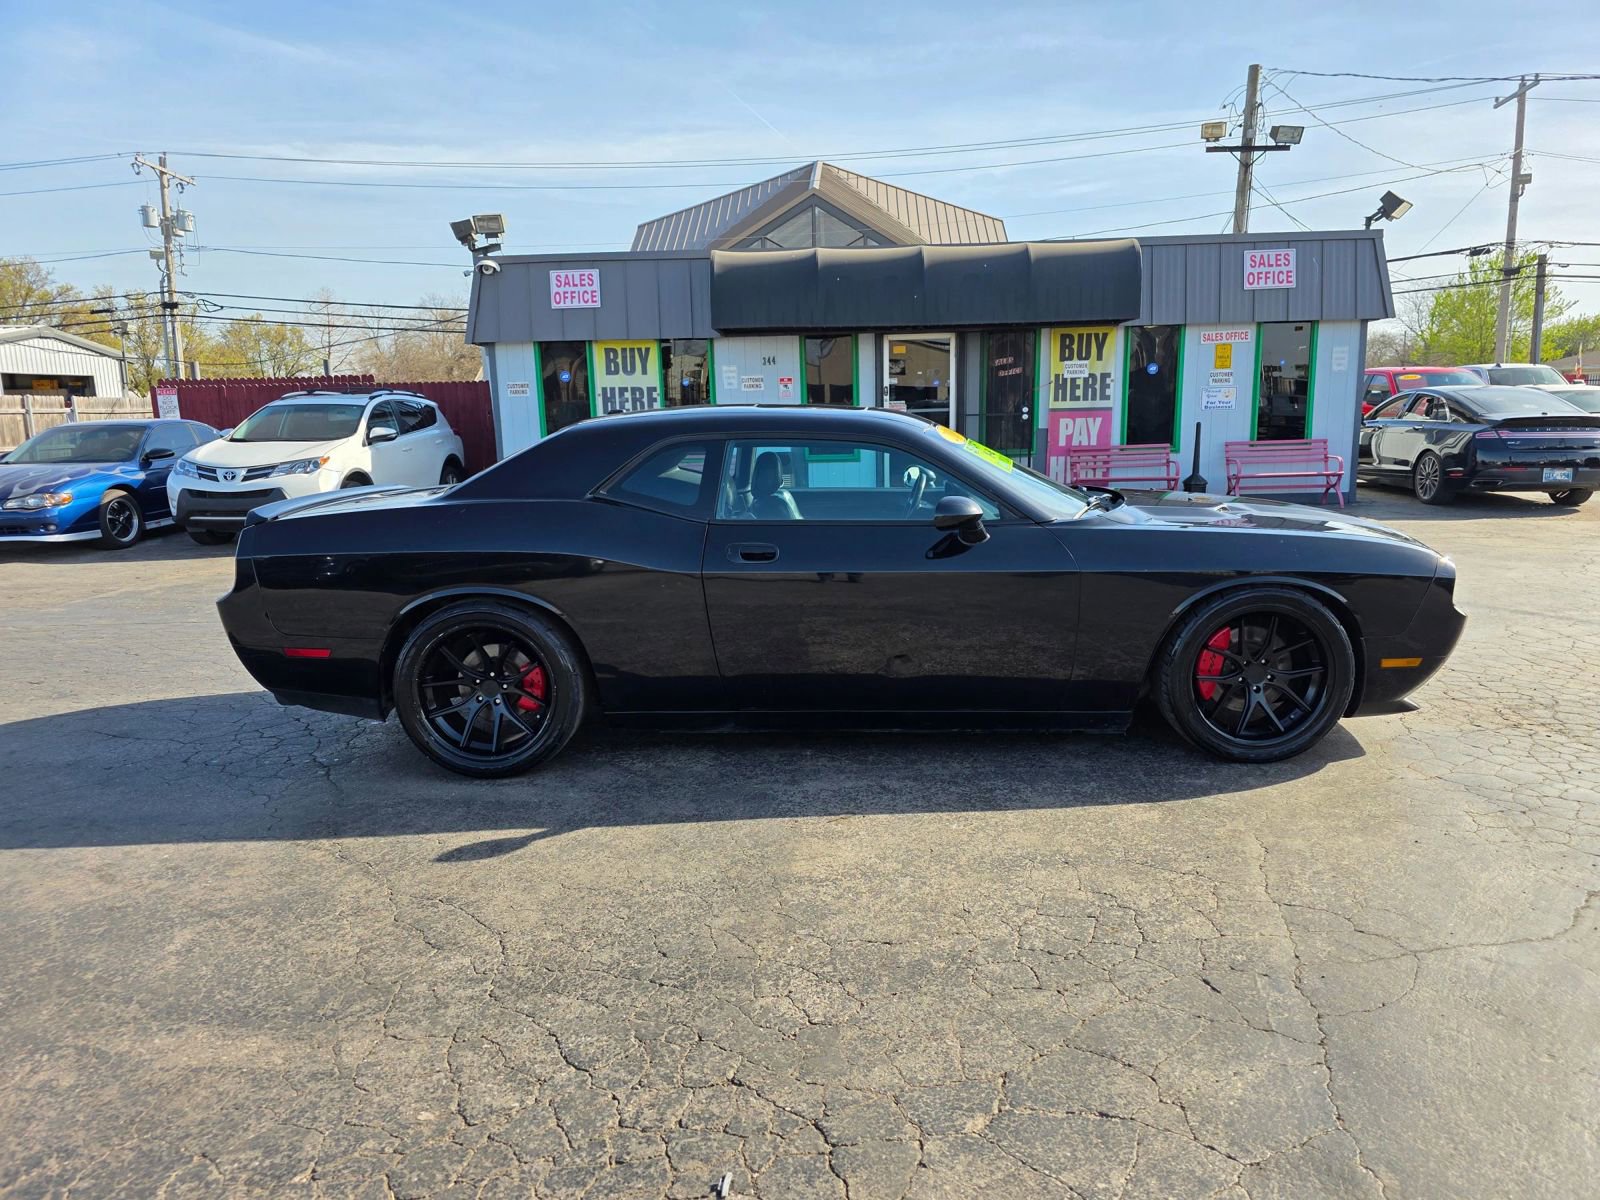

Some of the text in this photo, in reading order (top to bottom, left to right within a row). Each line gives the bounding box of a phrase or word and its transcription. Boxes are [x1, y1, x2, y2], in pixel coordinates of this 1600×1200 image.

[1250, 252, 1291, 268] SALES
[555, 272, 594, 288] SALES
[1247, 270, 1293, 286] OFFICE
[554, 290, 598, 305] OFFICE
[1202, 331, 1249, 342] SALES OFFICE
[1058, 332, 1109, 362] BUY
[604, 347, 651, 376] BUY
[762, 356, 776, 366] 344
[1053, 372, 1112, 402] HERE
[602, 386, 658, 414] HERE
[1058, 417, 1102, 447] PAY
